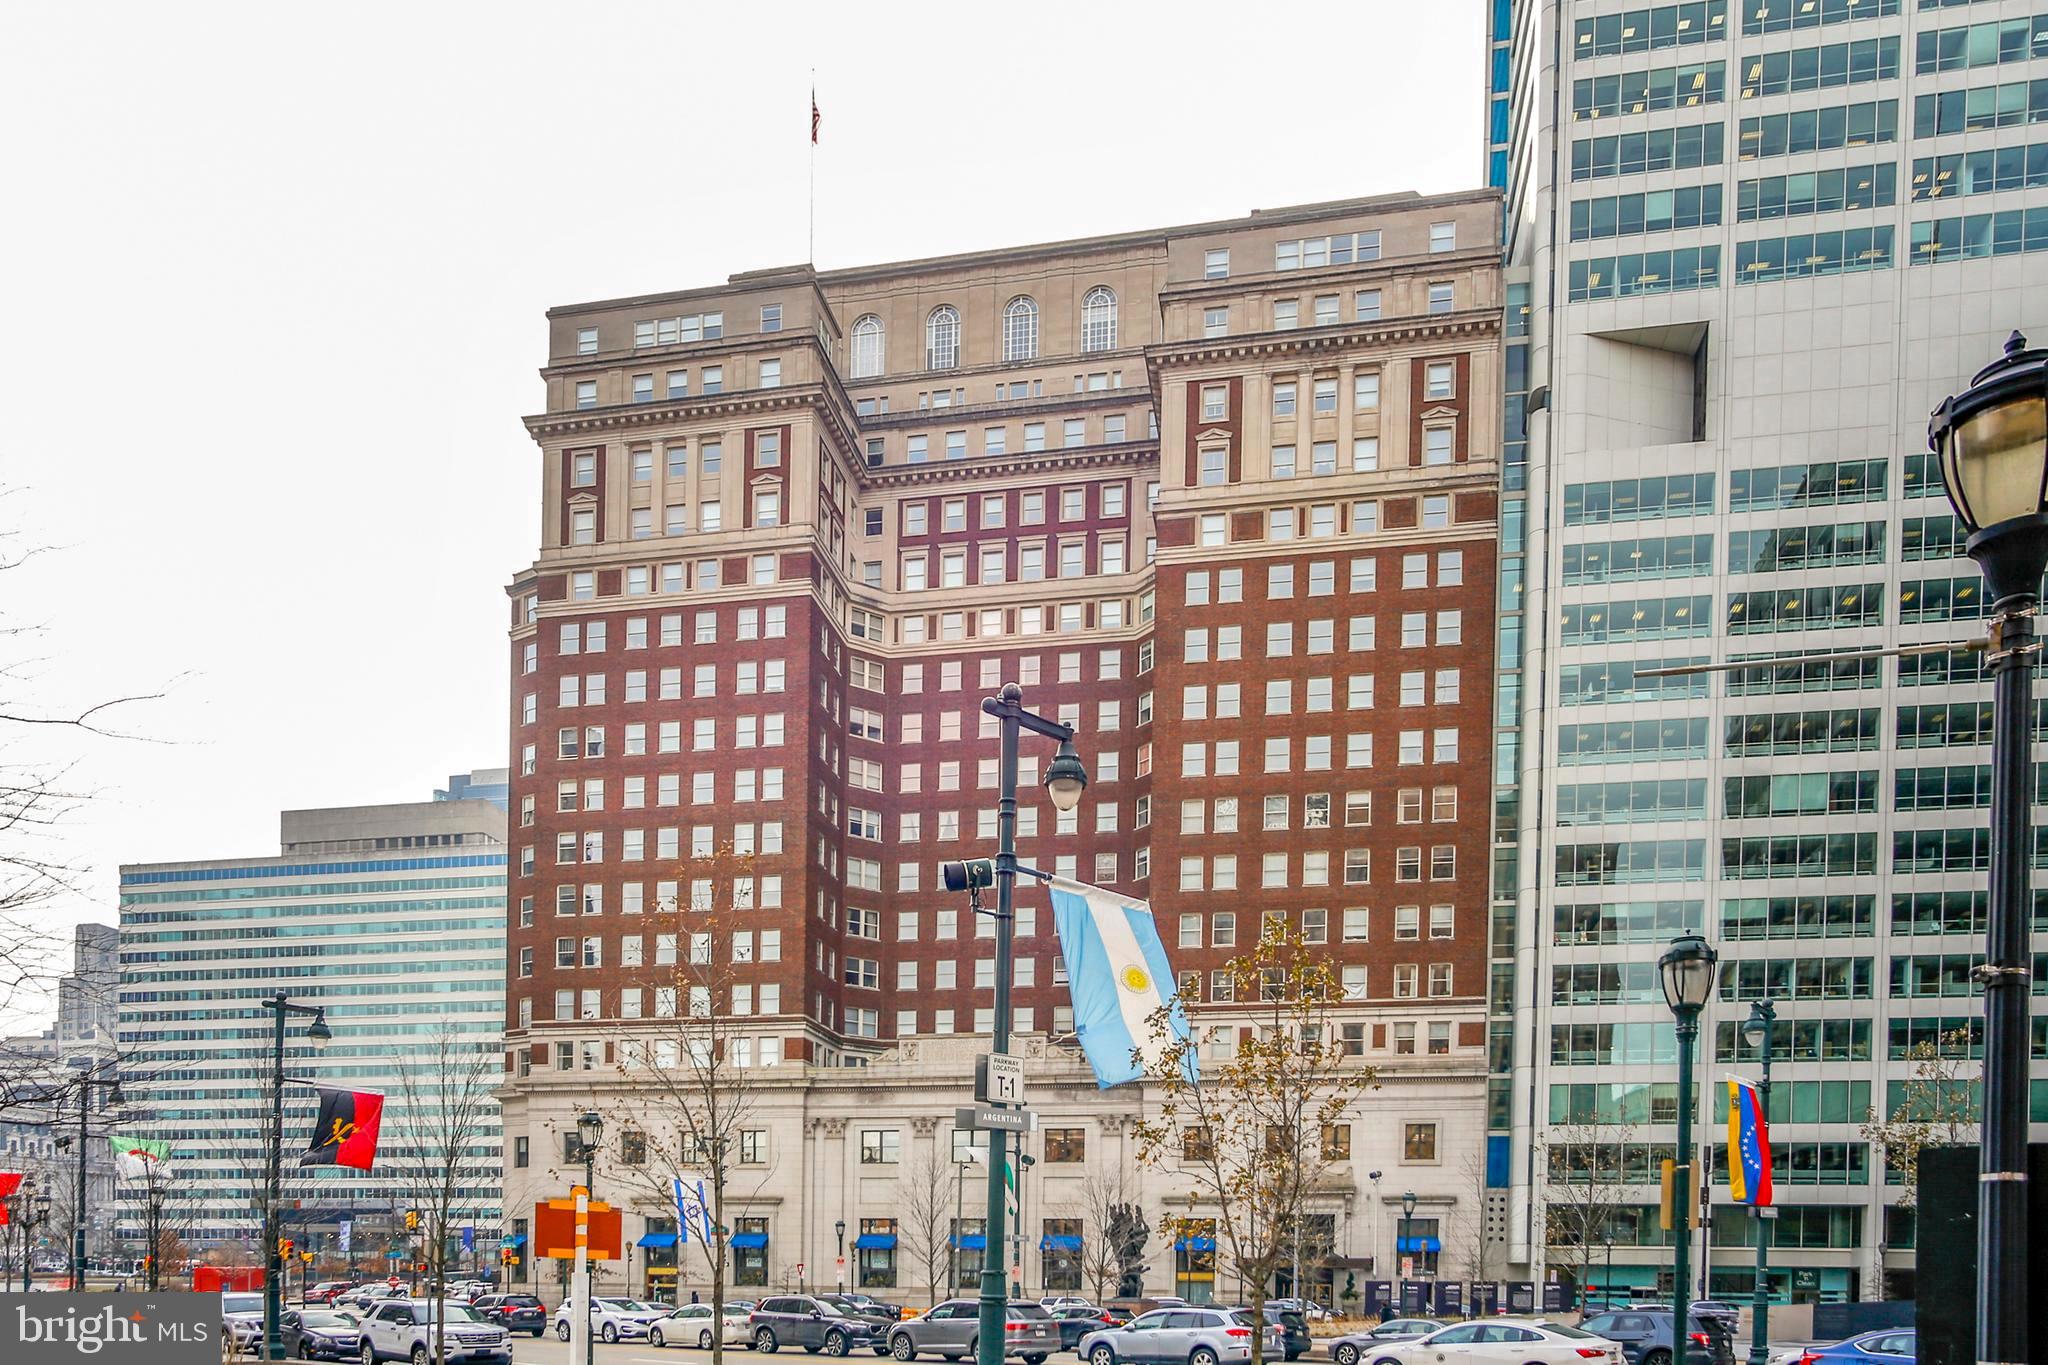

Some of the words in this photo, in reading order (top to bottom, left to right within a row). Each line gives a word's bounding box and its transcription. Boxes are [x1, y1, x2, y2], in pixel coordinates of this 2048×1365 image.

[993, 1058, 1019, 1066] PARKWAY
[993, 1064, 1020, 1073] LOCATION
[997, 1075, 1015, 1098] T-1
[983, 1112, 1022, 1124] ARGENTINA
